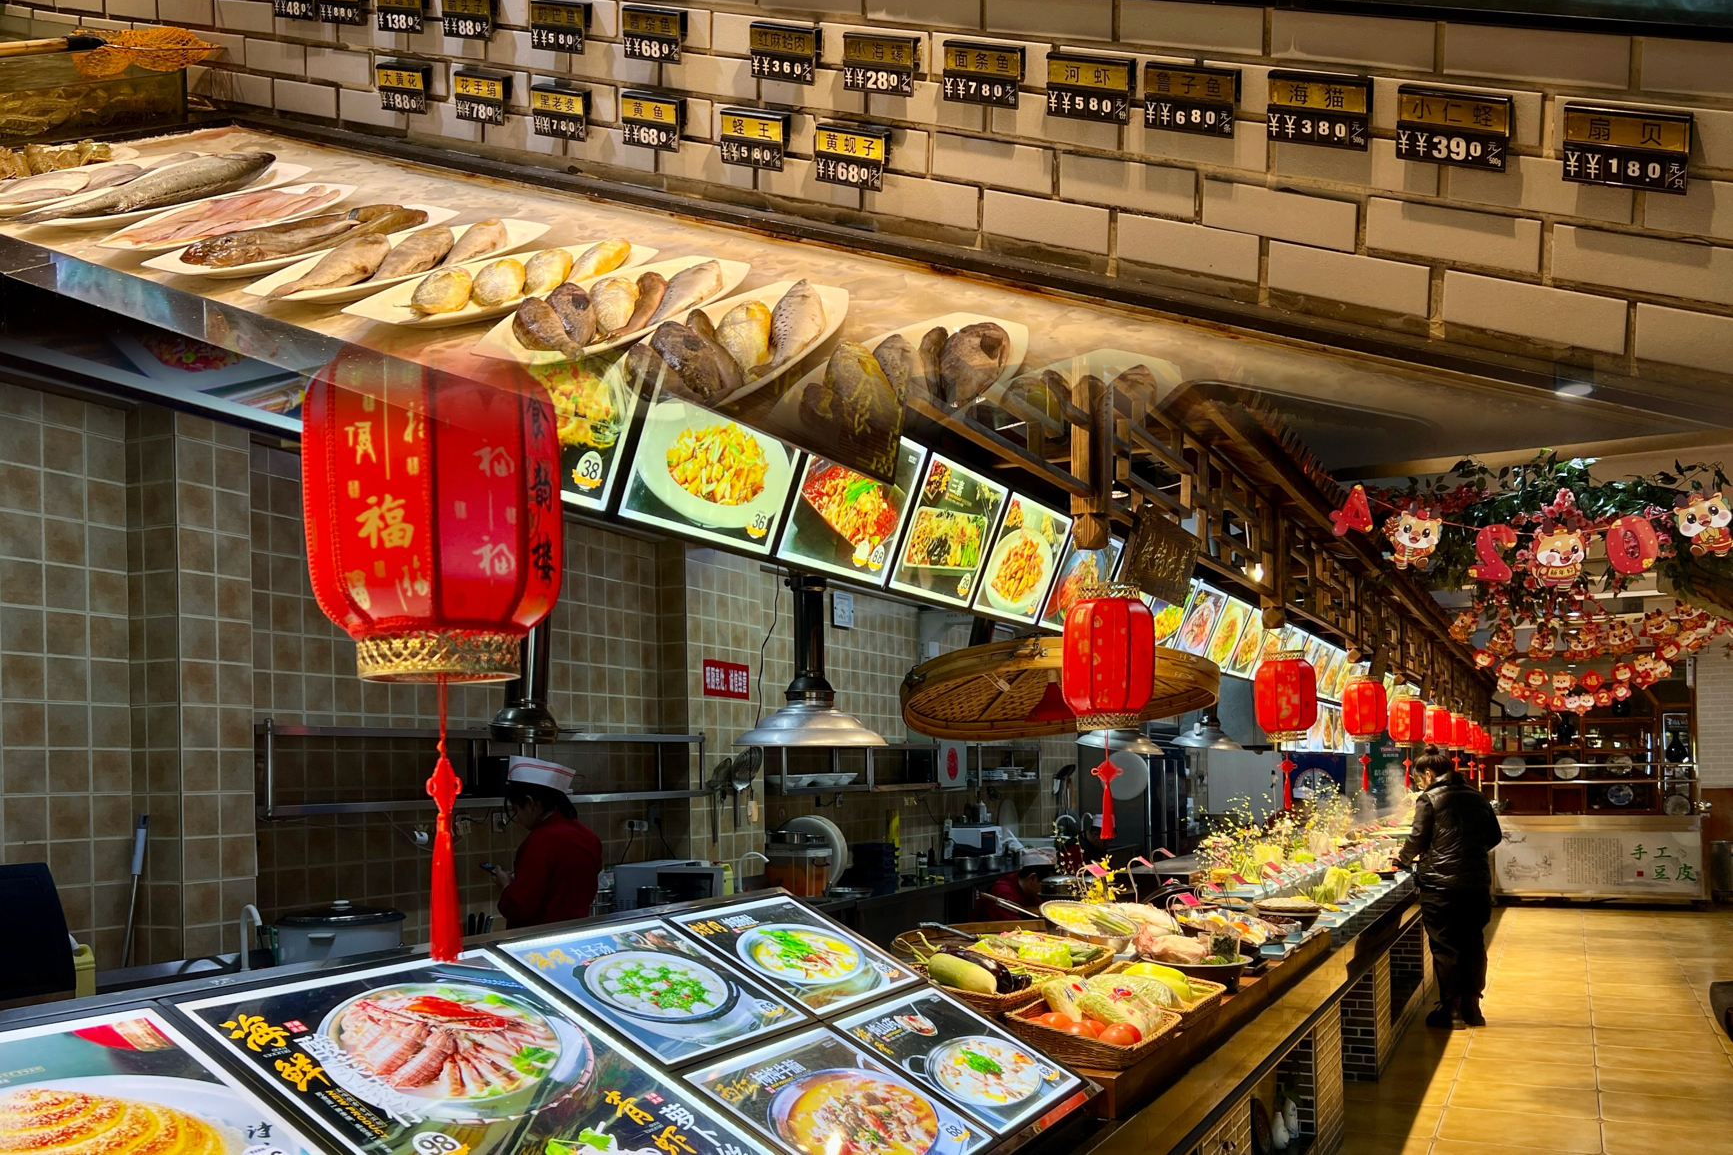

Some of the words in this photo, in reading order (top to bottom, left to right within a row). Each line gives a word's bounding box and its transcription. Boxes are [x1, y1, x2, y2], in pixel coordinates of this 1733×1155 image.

[758, 31, 805, 52] 红麻蛤肉
[852, 42, 903, 62] 小海螺
[955, 50, 1010, 73] 面条鱼
[383, 71, 417, 87] 大黄花
[1064, 64, 1110, 86] 河虾
[1155, 72, 1221, 98] 鲁子鱼
[461, 78, 496, 97] 花手绢
[1289, 84, 1345, 109] 海猫
[540, 94, 575, 113] 黑老婆
[633, 102, 664, 120] 黄鱼
[1412, 98, 1493, 127] 小仁蛏
[733, 118, 772, 140] 蛏王
[1588, 118, 1663, 146] 扇贝
[826, 133, 875, 156] 黄蚬子
[582, 458, 601, 481] 38
[356, 493, 415, 549] 福
[752, 513, 767, 531] 36
[872, 549, 884, 564] 88
[1550, 567, 1574, 577] 新年好
[1536, 694, 1545, 704] 2
[1553, 696, 1562, 706] 4
[1599, 692, 1608, 703] 2
[1630, 843, 1672, 861] 手工
[1652, 863, 1696, 882] 豆皮
[570, 942, 616, 959] 丸子汤
[760, 1002, 776, 1013] 68
[219, 1014, 331, 1092] 海鲜
[325, 1090, 349, 1106] NEW
[345, 1106, 390, 1139] PRODUCT
[946, 1125, 963, 1137] 68
[419, 1135, 457, 1155] 98
